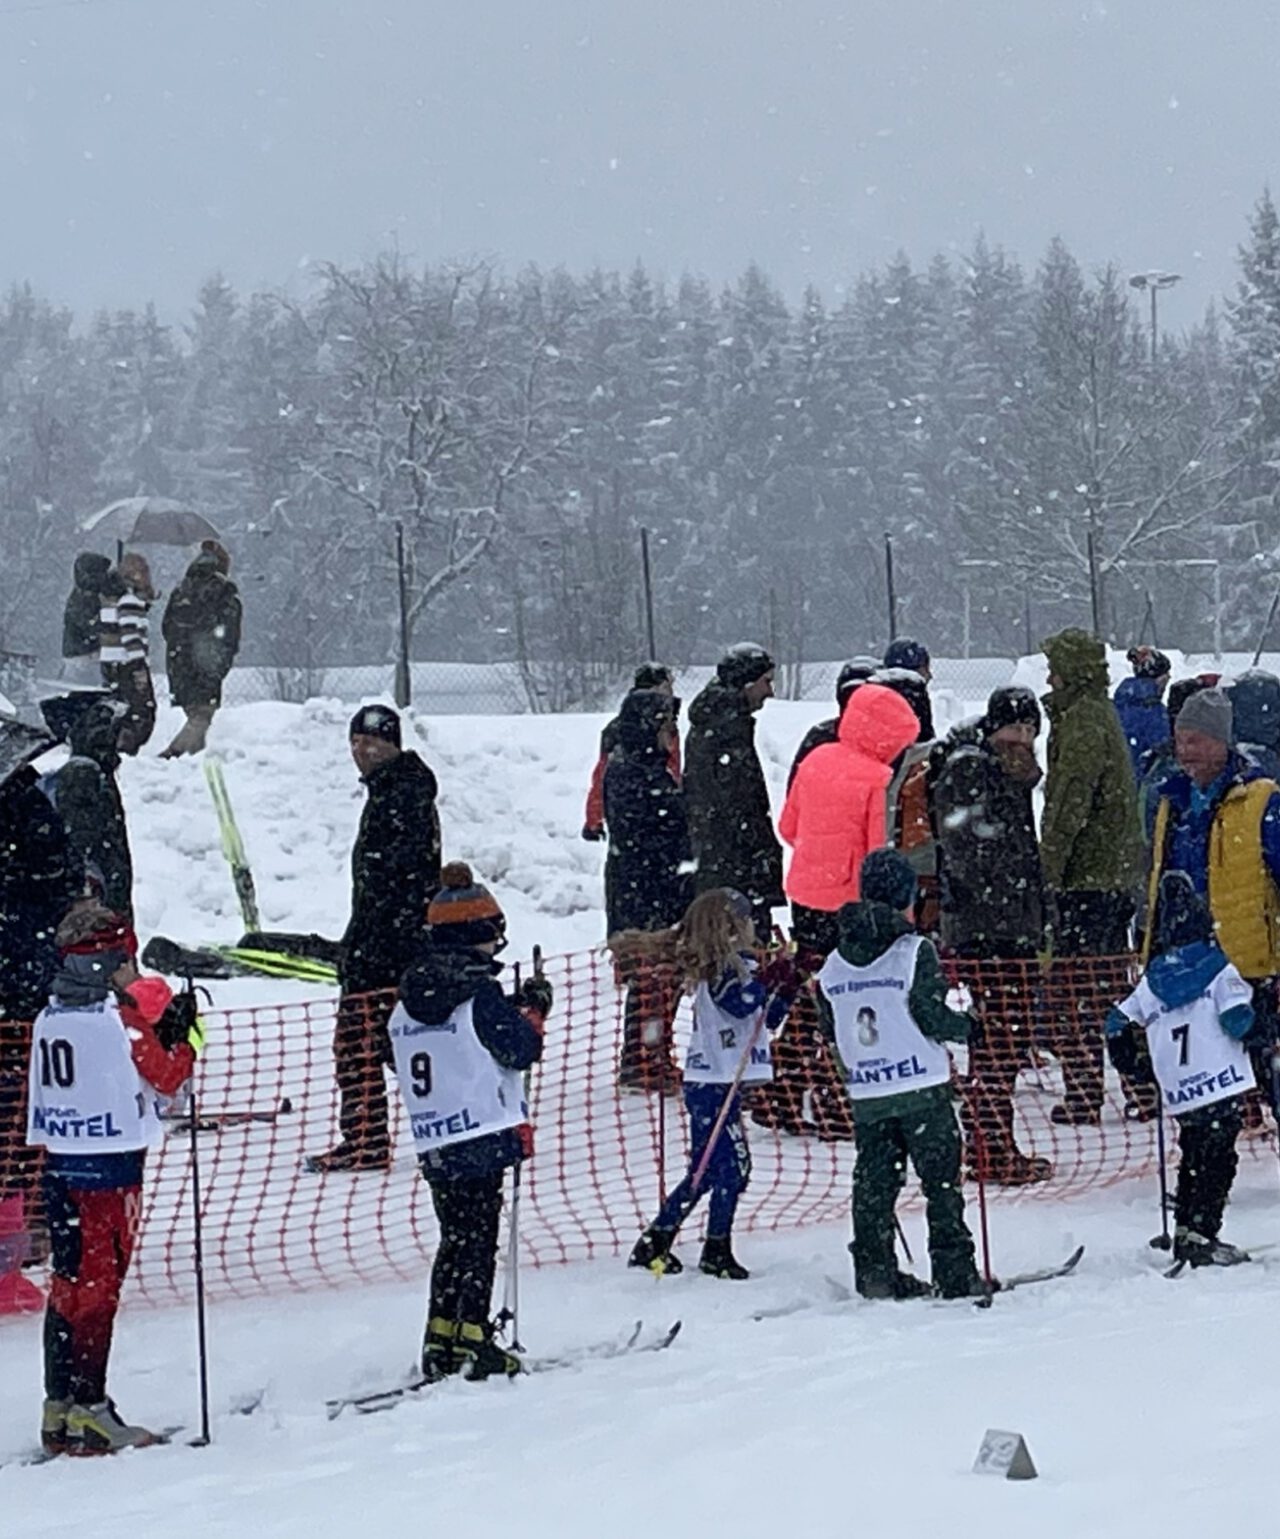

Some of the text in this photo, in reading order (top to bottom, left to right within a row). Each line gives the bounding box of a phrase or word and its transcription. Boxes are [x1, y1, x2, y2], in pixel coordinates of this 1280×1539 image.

[719, 1028, 737, 1049] 12
[1171, 1023, 1190, 1067] 7
[39, 1037, 75, 1088] 10
[410, 1051, 432, 1099] 9
[32, 1106, 122, 1138] MNTEL
[412, 1108, 480, 1138] ANTEL
